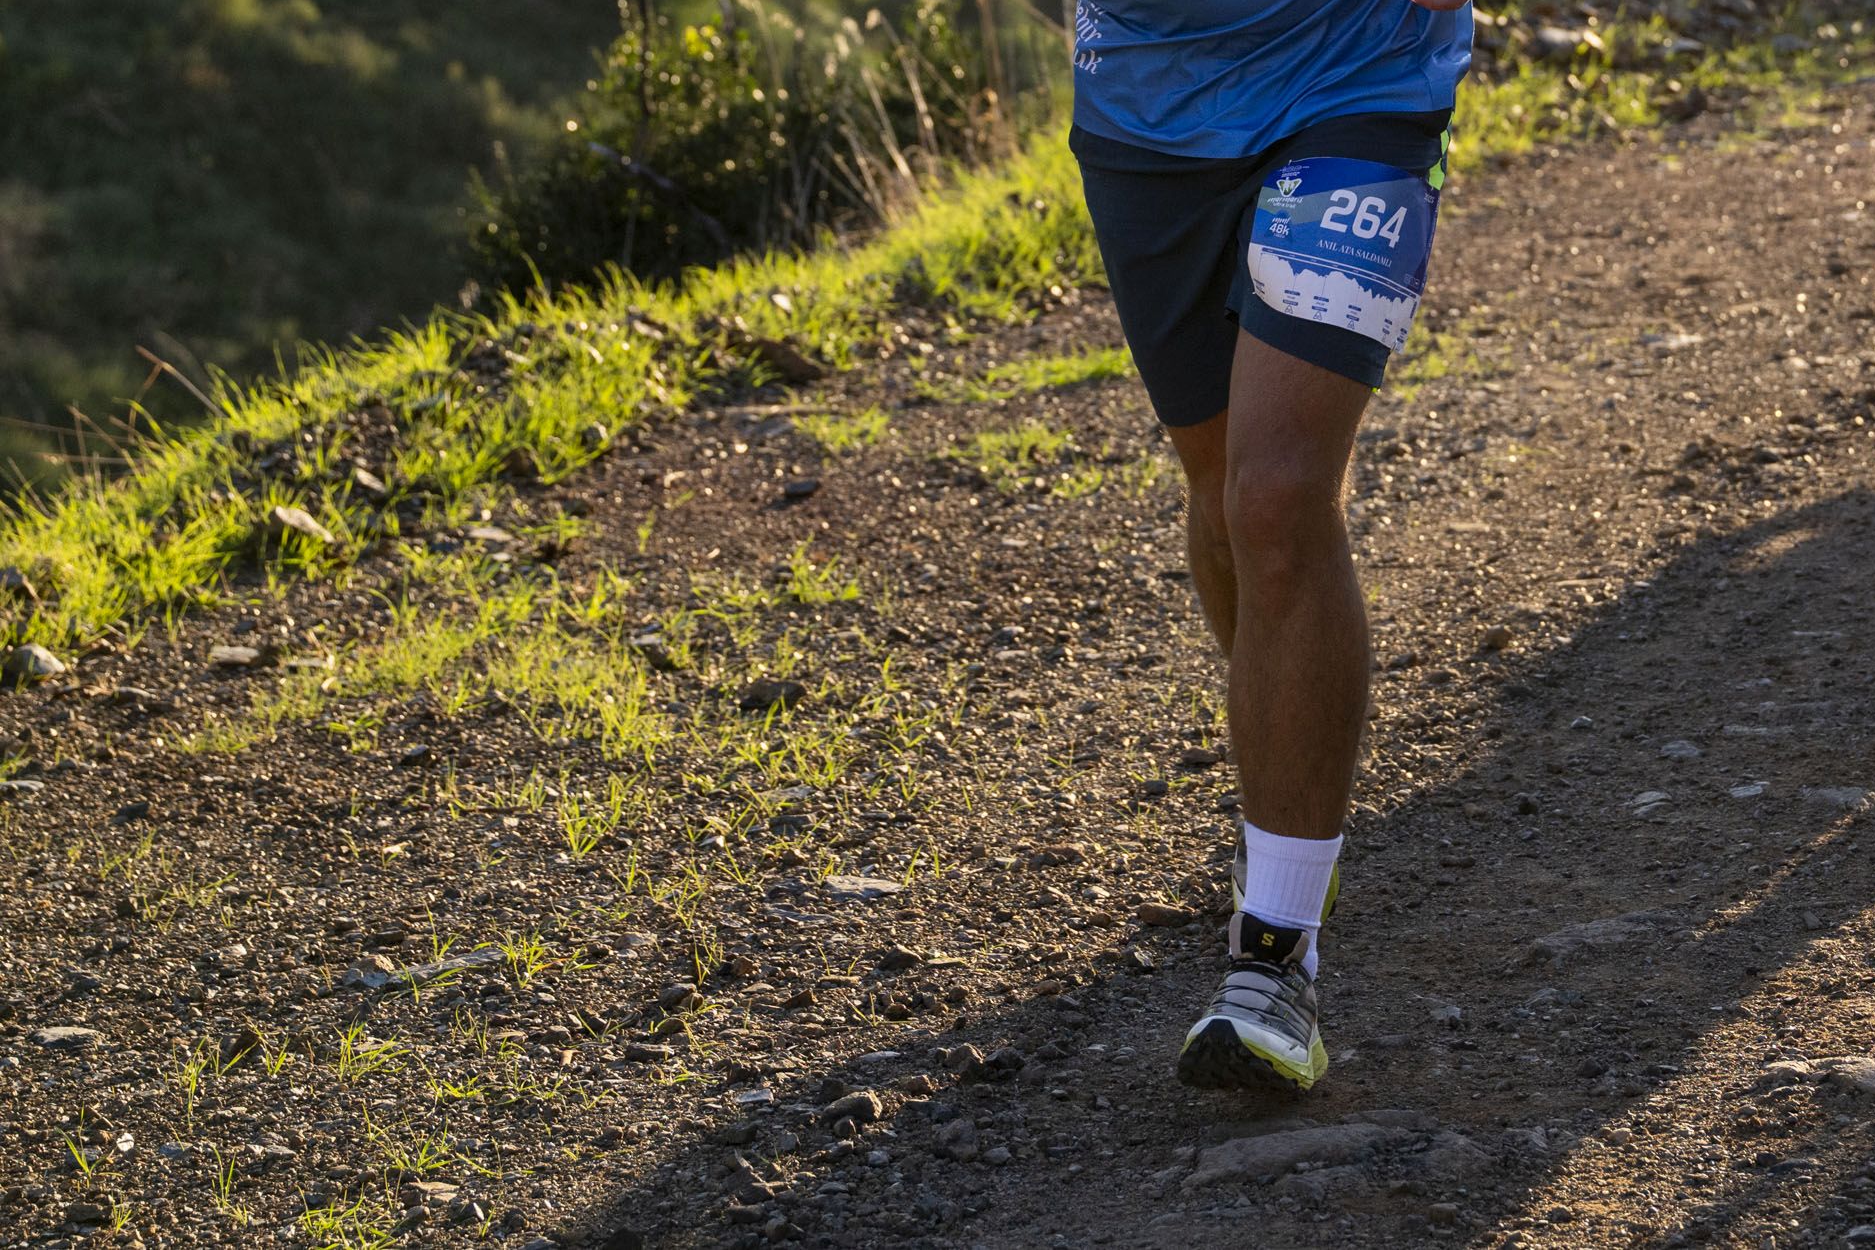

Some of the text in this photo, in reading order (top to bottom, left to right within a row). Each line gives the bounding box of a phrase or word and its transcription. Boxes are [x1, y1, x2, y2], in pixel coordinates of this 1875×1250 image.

[1320, 189, 1407, 248] 264
[1269, 223, 1290, 236] 48k
[1316, 239, 1338, 251] ANIL
[1339, 244, 1355, 256] ATA
